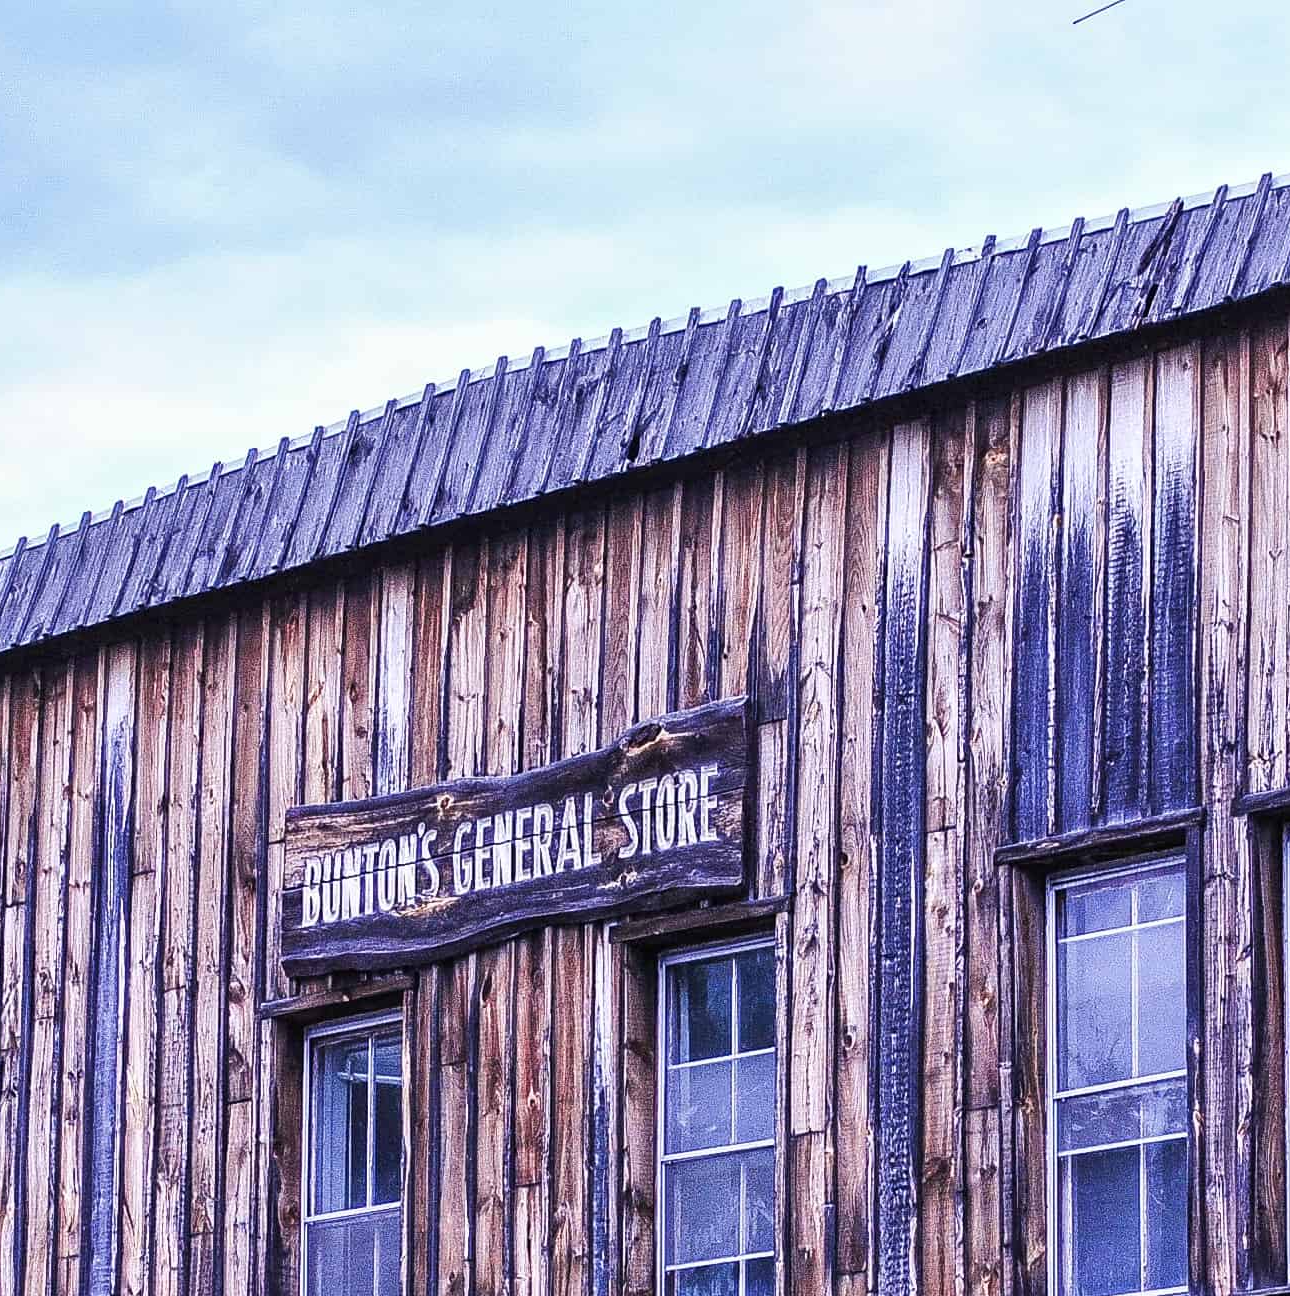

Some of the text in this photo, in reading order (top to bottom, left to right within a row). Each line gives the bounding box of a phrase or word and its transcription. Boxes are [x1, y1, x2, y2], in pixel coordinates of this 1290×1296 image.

[300, 766, 720, 928] BUNTON'S GENERAL STORE
